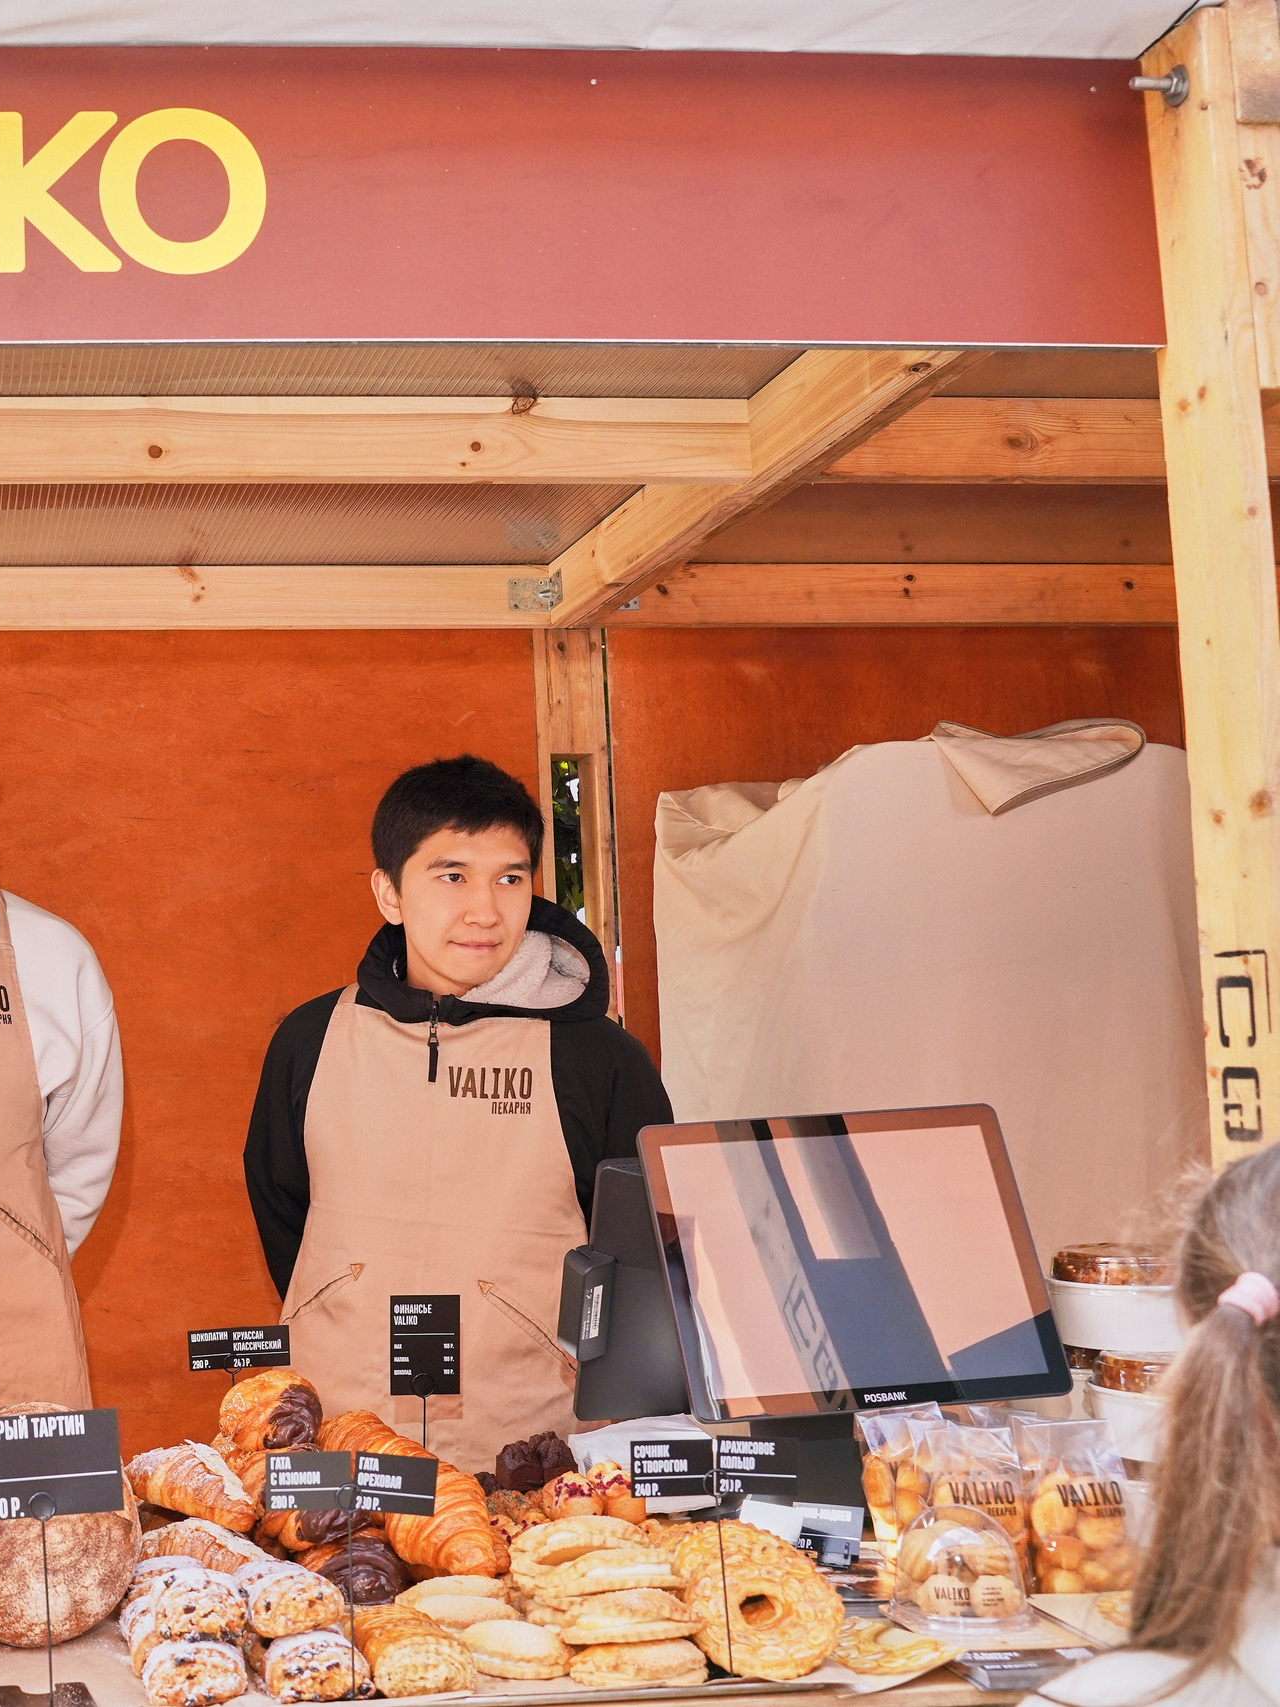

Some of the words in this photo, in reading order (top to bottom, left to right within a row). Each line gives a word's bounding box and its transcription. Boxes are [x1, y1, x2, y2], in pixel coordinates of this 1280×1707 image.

[448, 1066, 533, 1100] VALIKO
[491, 1101, 532, 1115] ПЕКАРНЯ
[393, 1304, 432, 1314] ФИНАНСЬЕ
[393, 1315, 418, 1326] VALIKO
[190, 1331, 229, 1343] ШОКОЛАТИН
[232, 1330, 264, 1341] КРУАССАН
[233, 1339, 282, 1352] КЛАССИЧЕСКИЙ
[204, 1359, 211, 1369] Р.
[246, 1357, 253, 1367] Р.
[863, 1391, 908, 1404] POSBANK
[31, 1414, 86, 1439] ТАРТИН
[633, 1444, 670, 1459] СОЧНИК
[720, 1440, 776, 1456] АРАХИСОВОЕ
[270, 1456, 292, 1470] ГАТА
[358, 1456, 380, 1472] ГАТА
[633, 1460, 641, 1474] С
[642, 1459, 688, 1473] ТВОРОГОМ
[720, 1455, 756, 1472] КОЛЬЦО
[270, 1472, 277, 1486] С
[278, 1471, 321, 1486] ИЗЮМОМ
[357, 1472, 402, 1490] ОРЕХОВАЯ
[734, 1479, 744, 1493] Р.
[634, 1483, 652, 1497] 240
[652, 1482, 662, 1496] Р.
[948, 1480, 1015, 1506] VALIKO
[1056, 1480, 1123, 1508] VALIKO
[10, 1496, 25, 1518] Р.
[288, 1495, 298, 1509] Р.
[372, 1497, 382, 1512] Р.
[987, 1506, 1017, 1517] ПЕКАРНЯ
[934, 1586, 970, 1601] VALIKO
